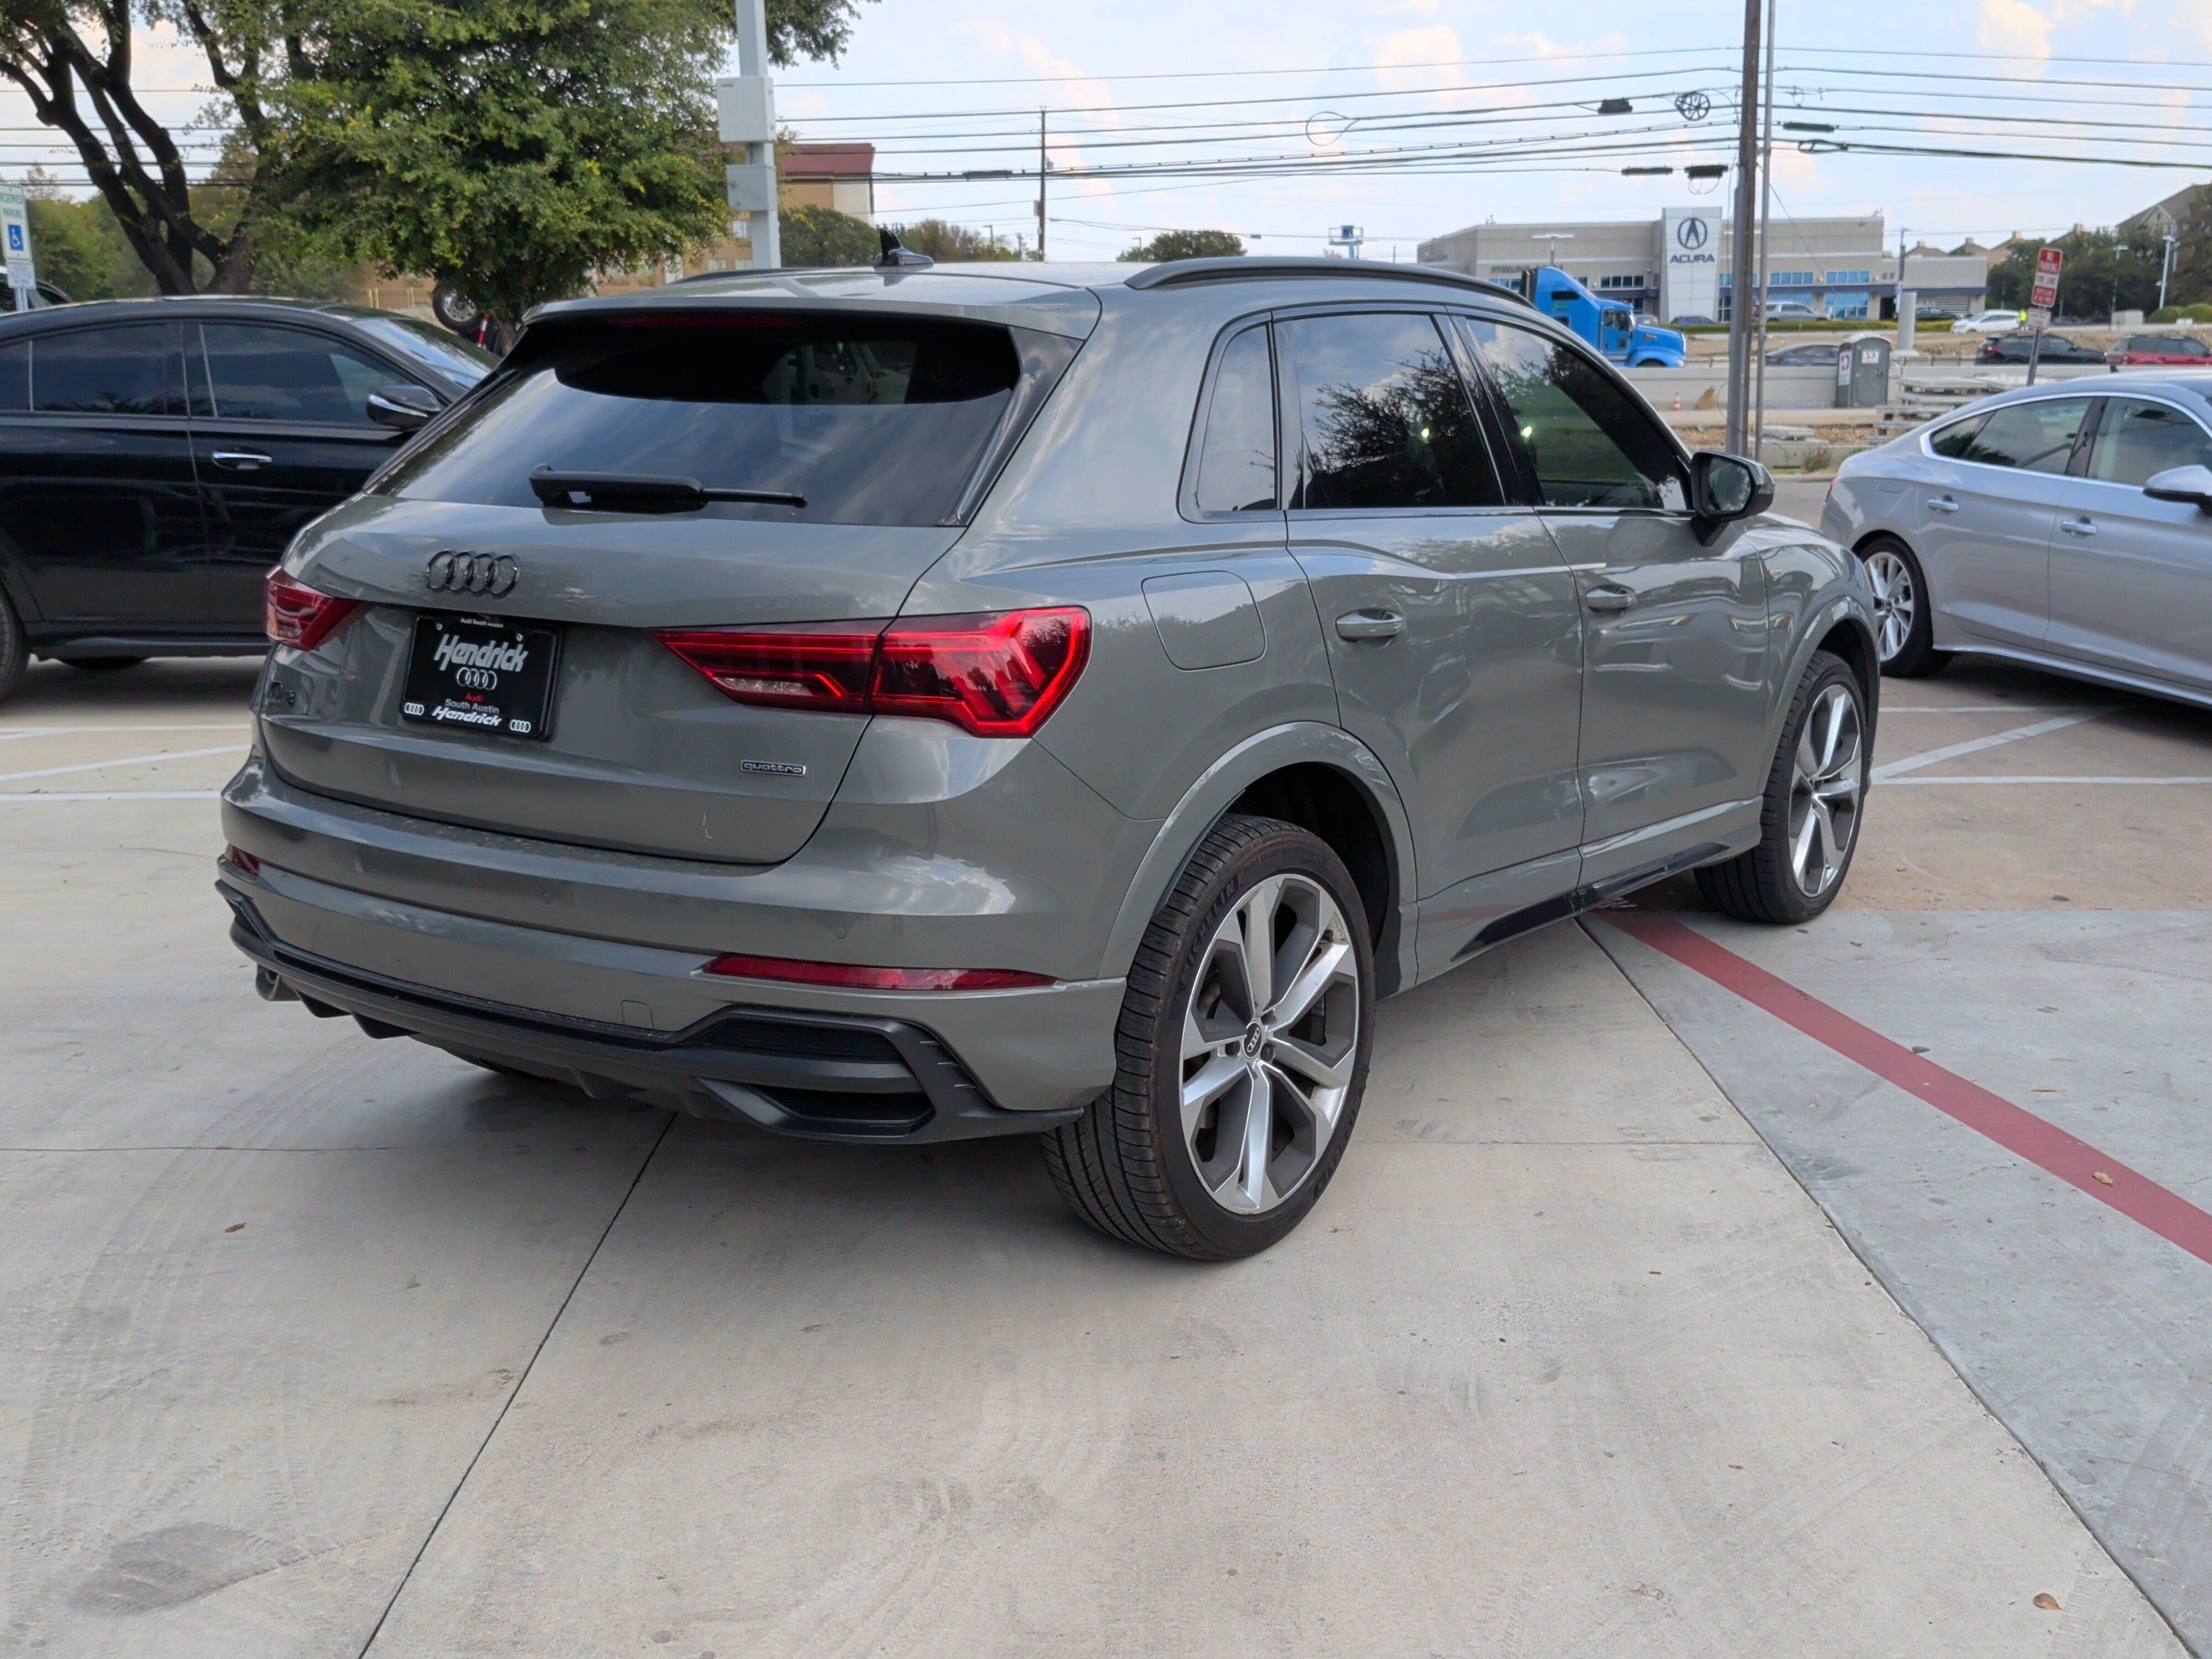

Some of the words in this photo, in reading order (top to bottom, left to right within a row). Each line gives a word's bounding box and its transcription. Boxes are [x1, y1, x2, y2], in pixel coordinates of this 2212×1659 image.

[1670, 254, 1715, 263] ACURA
[434, 634, 528, 672] Hendrick
[466, 692, 484, 702] Audi
[445, 698, 470, 710] South
[472, 703, 499, 713] Austin
[432, 706, 502, 726] Hendrick
[743, 763, 802, 773] quattro
[1179, 879, 1235, 986] MICHELIN
